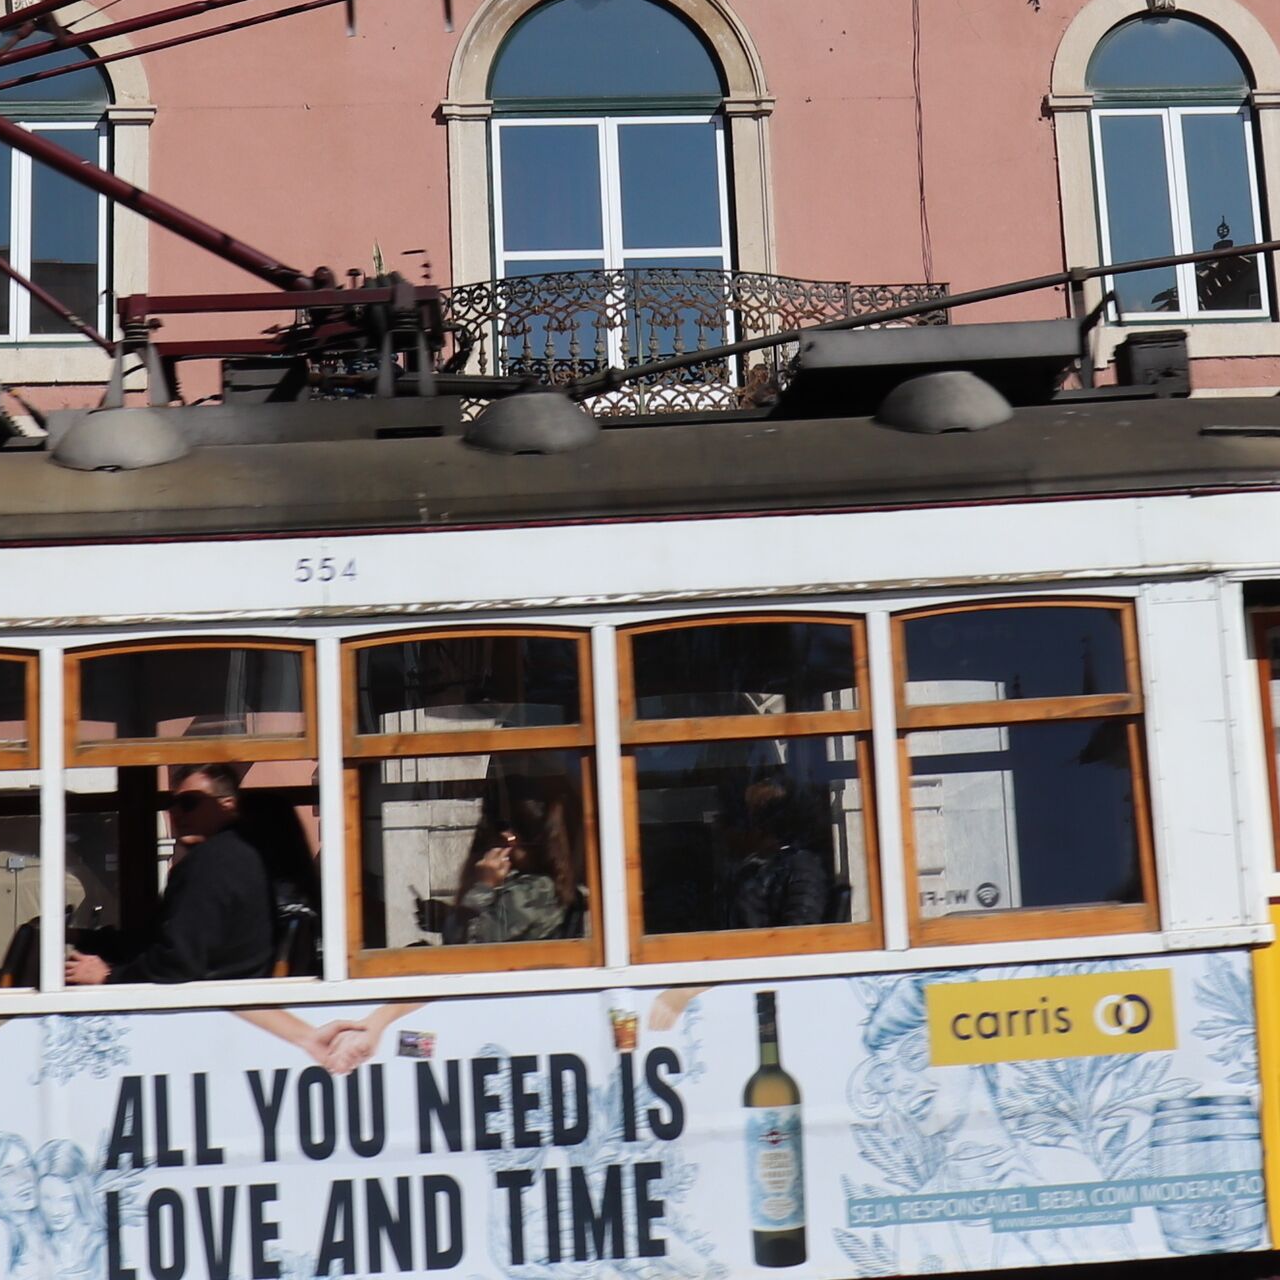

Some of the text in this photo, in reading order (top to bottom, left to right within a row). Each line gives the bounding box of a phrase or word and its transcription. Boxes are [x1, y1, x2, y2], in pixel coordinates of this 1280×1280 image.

[294, 557, 359, 582] 554
[951, 996, 1072, 1040] carris
[104, 1047, 686, 1170] ALL YOU NEED IS
[105, 1183, 281, 1280] LOVE
[314, 1174, 464, 1276] AND
[496, 1161, 667, 1265] TIME
[849, 1203, 897, 1223] SEJA
[1038, 1189, 1089, 1210] BEBA
[1090, 1186, 1137, 1207] COM
[1139, 1174, 1265, 1203] MODERAÇÃO
